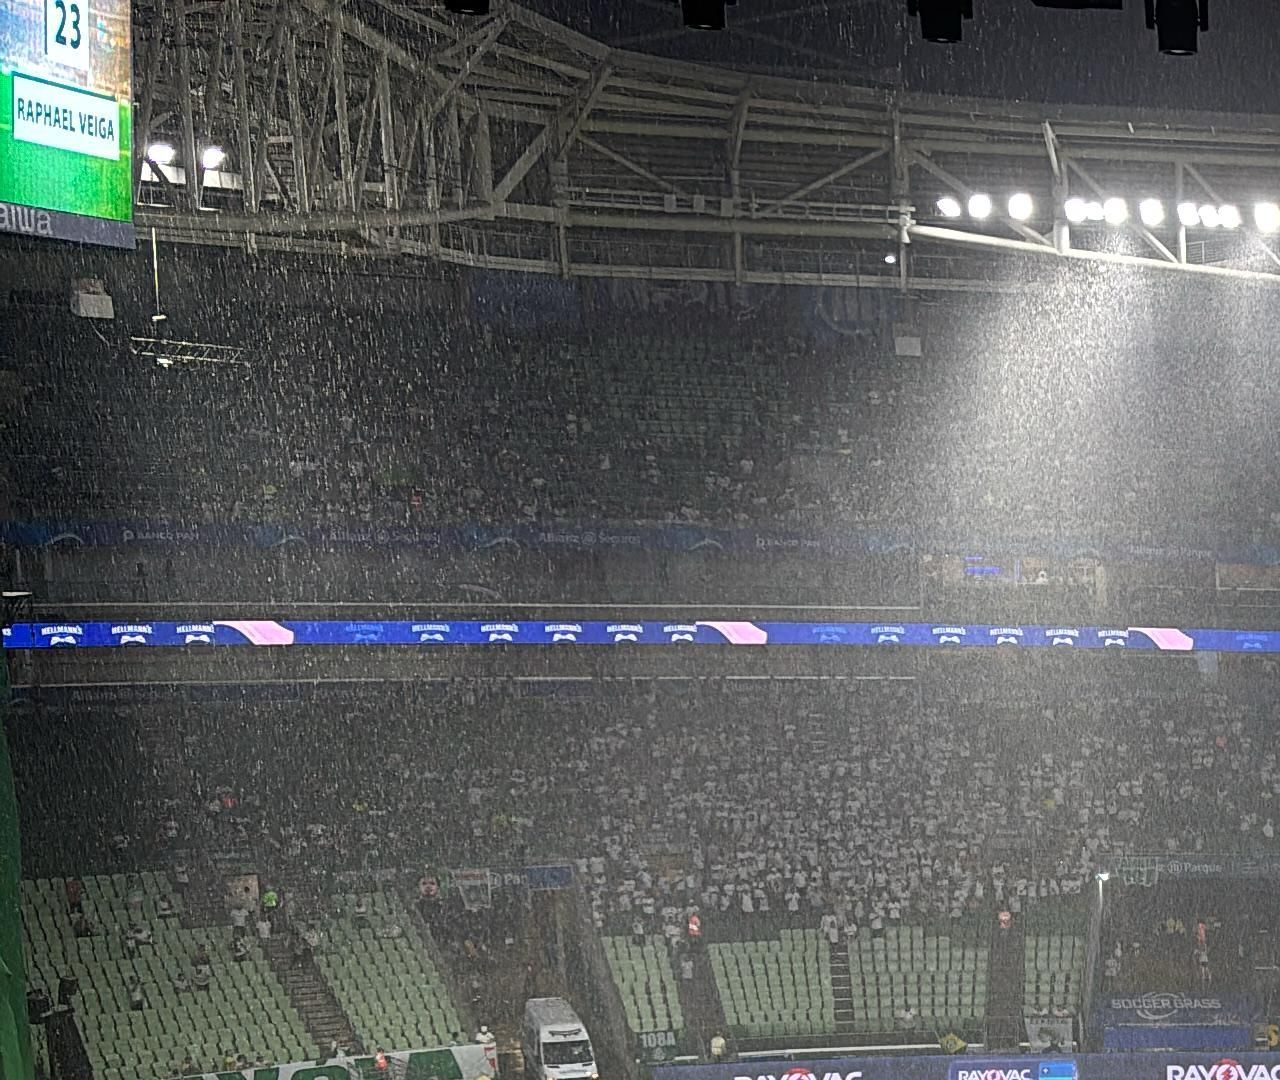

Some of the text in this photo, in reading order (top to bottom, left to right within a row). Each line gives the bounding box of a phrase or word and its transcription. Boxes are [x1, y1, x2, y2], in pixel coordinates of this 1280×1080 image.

[56, 0, 81, 49] 23
[18, 98, 114, 141] RAPHAEL VEIGA
[1111, 999, 1222, 1010] SOCCER GRASS
[640, 1032, 675, 1047] 108A
